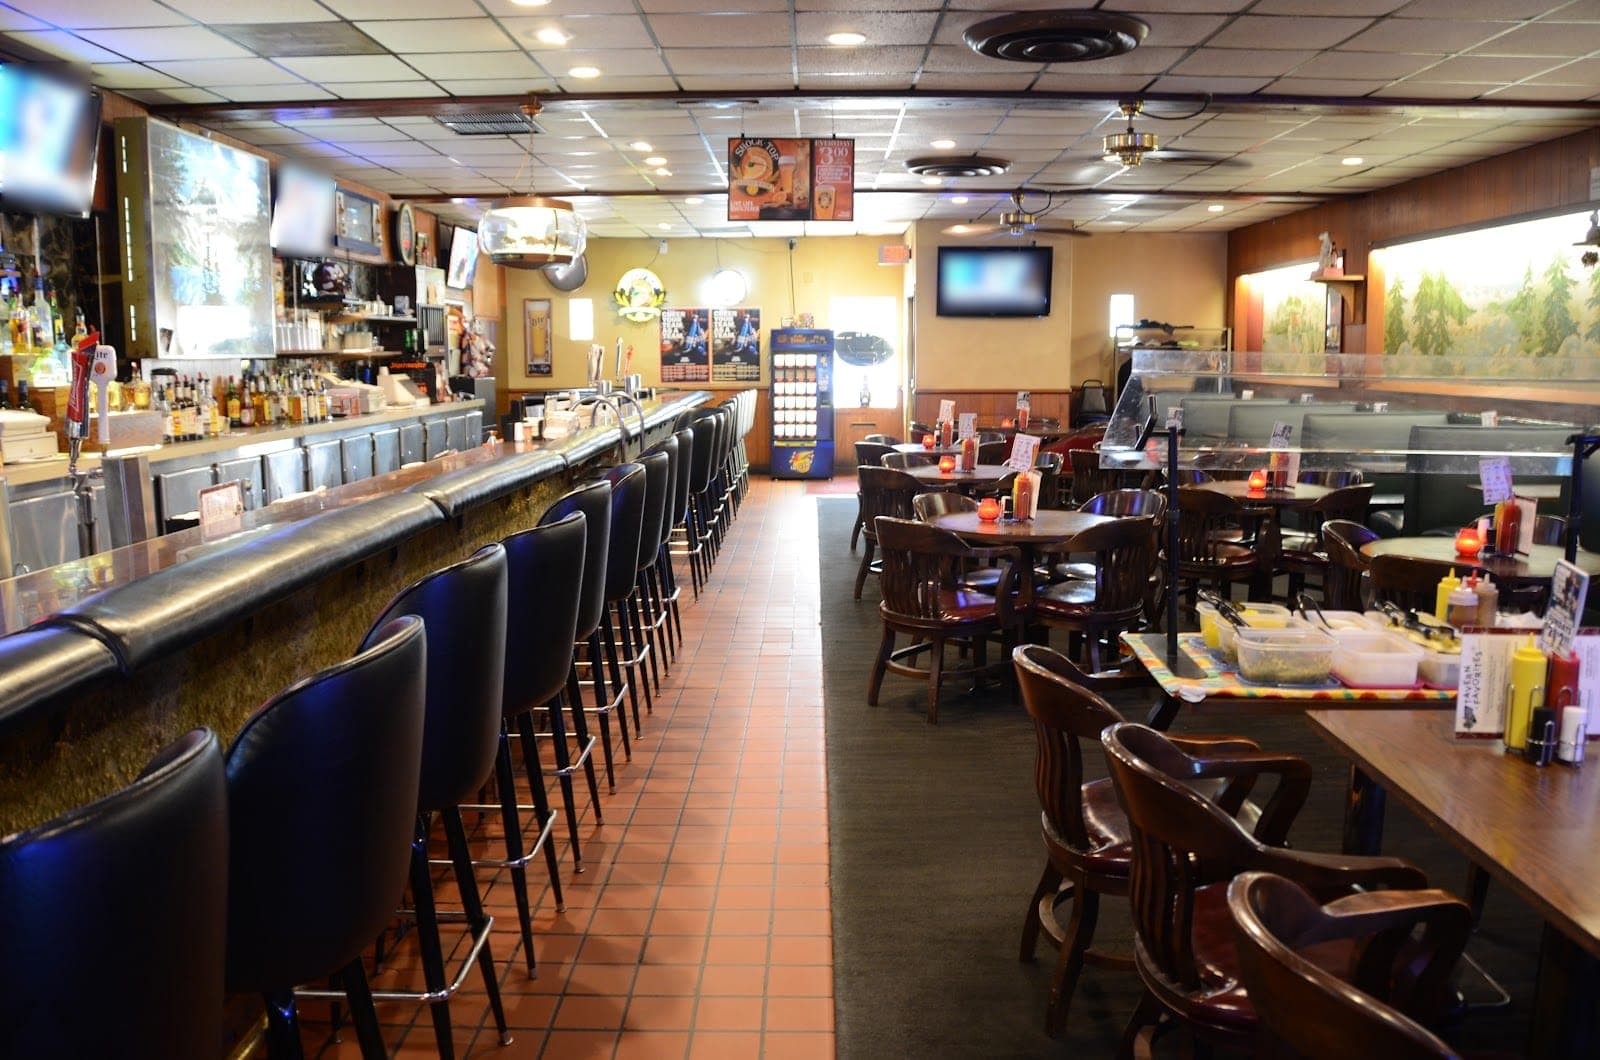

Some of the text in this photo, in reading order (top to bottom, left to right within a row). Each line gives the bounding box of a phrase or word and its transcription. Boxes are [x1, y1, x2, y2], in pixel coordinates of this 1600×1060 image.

[735, 139, 779, 160] SHOCK TOP
[1464, 666, 1472, 704] TAVERN
[1472, 651, 1482, 705] FAVORITES
